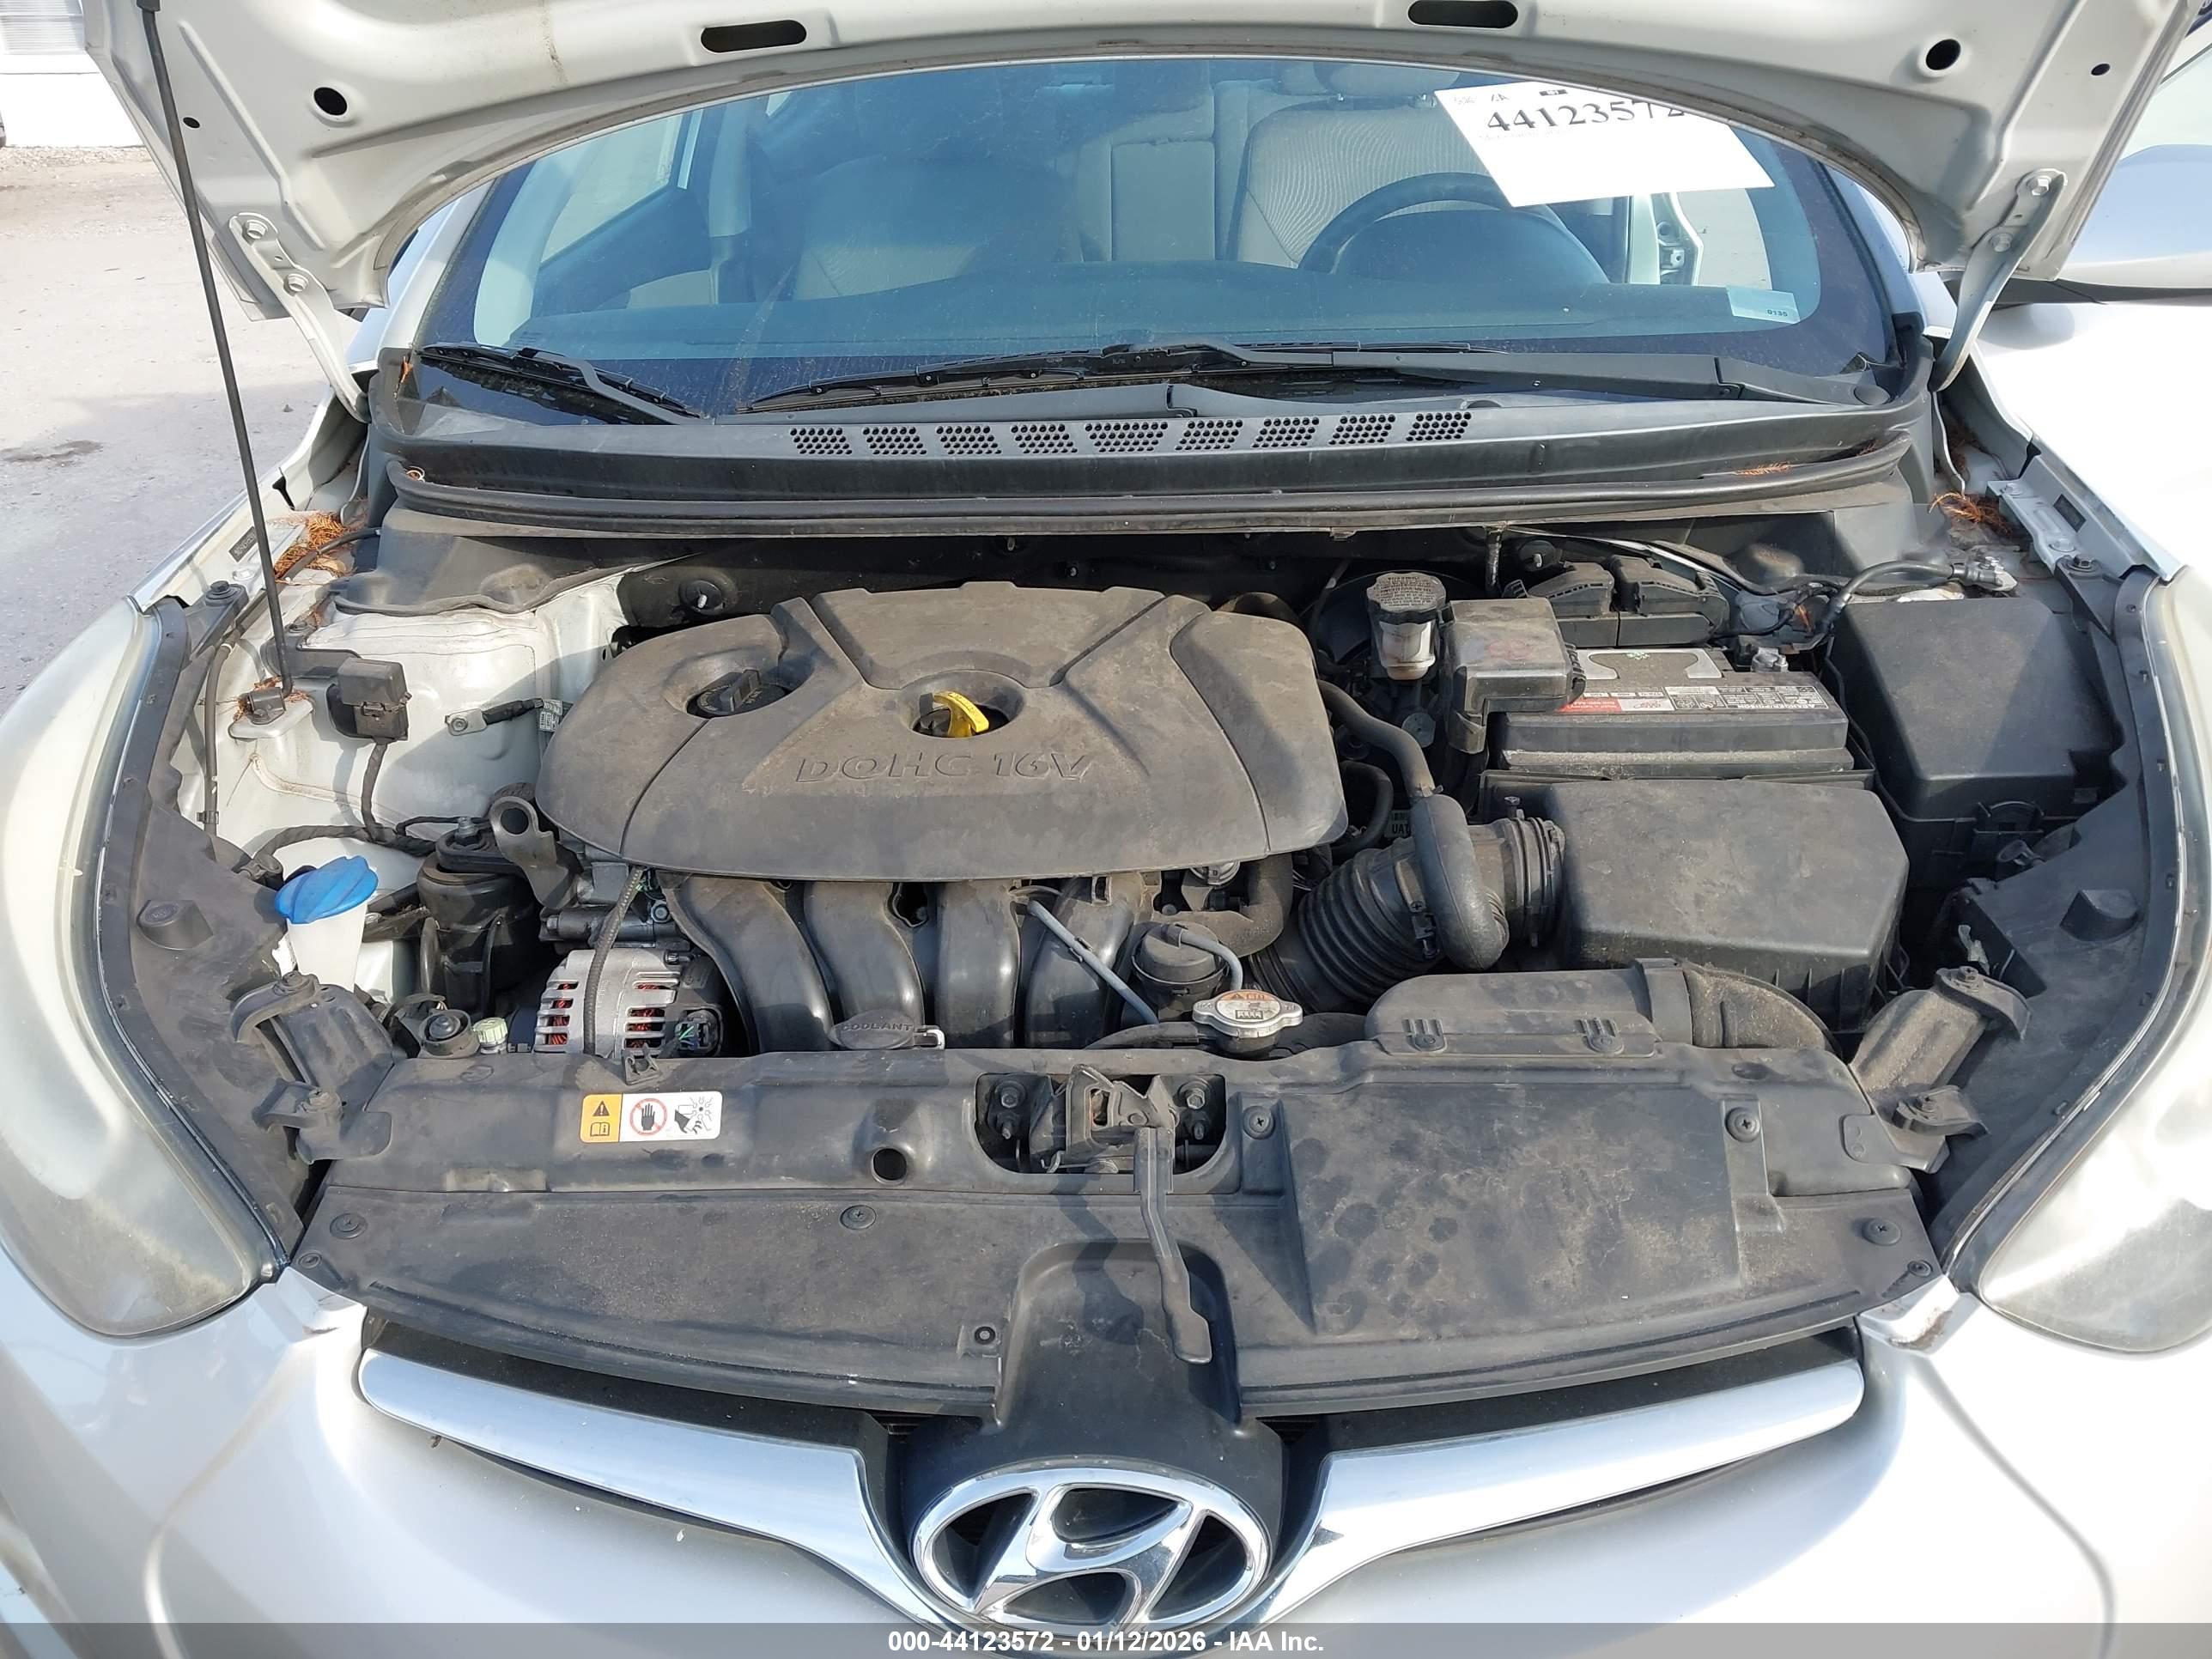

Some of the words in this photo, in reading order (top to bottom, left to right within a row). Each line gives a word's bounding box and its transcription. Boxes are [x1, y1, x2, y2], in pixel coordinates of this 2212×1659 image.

[794, 752, 973, 783] DOHC
[993, 752, 1093, 781] 16V
[842, 1022, 913, 1031] COOLANT
